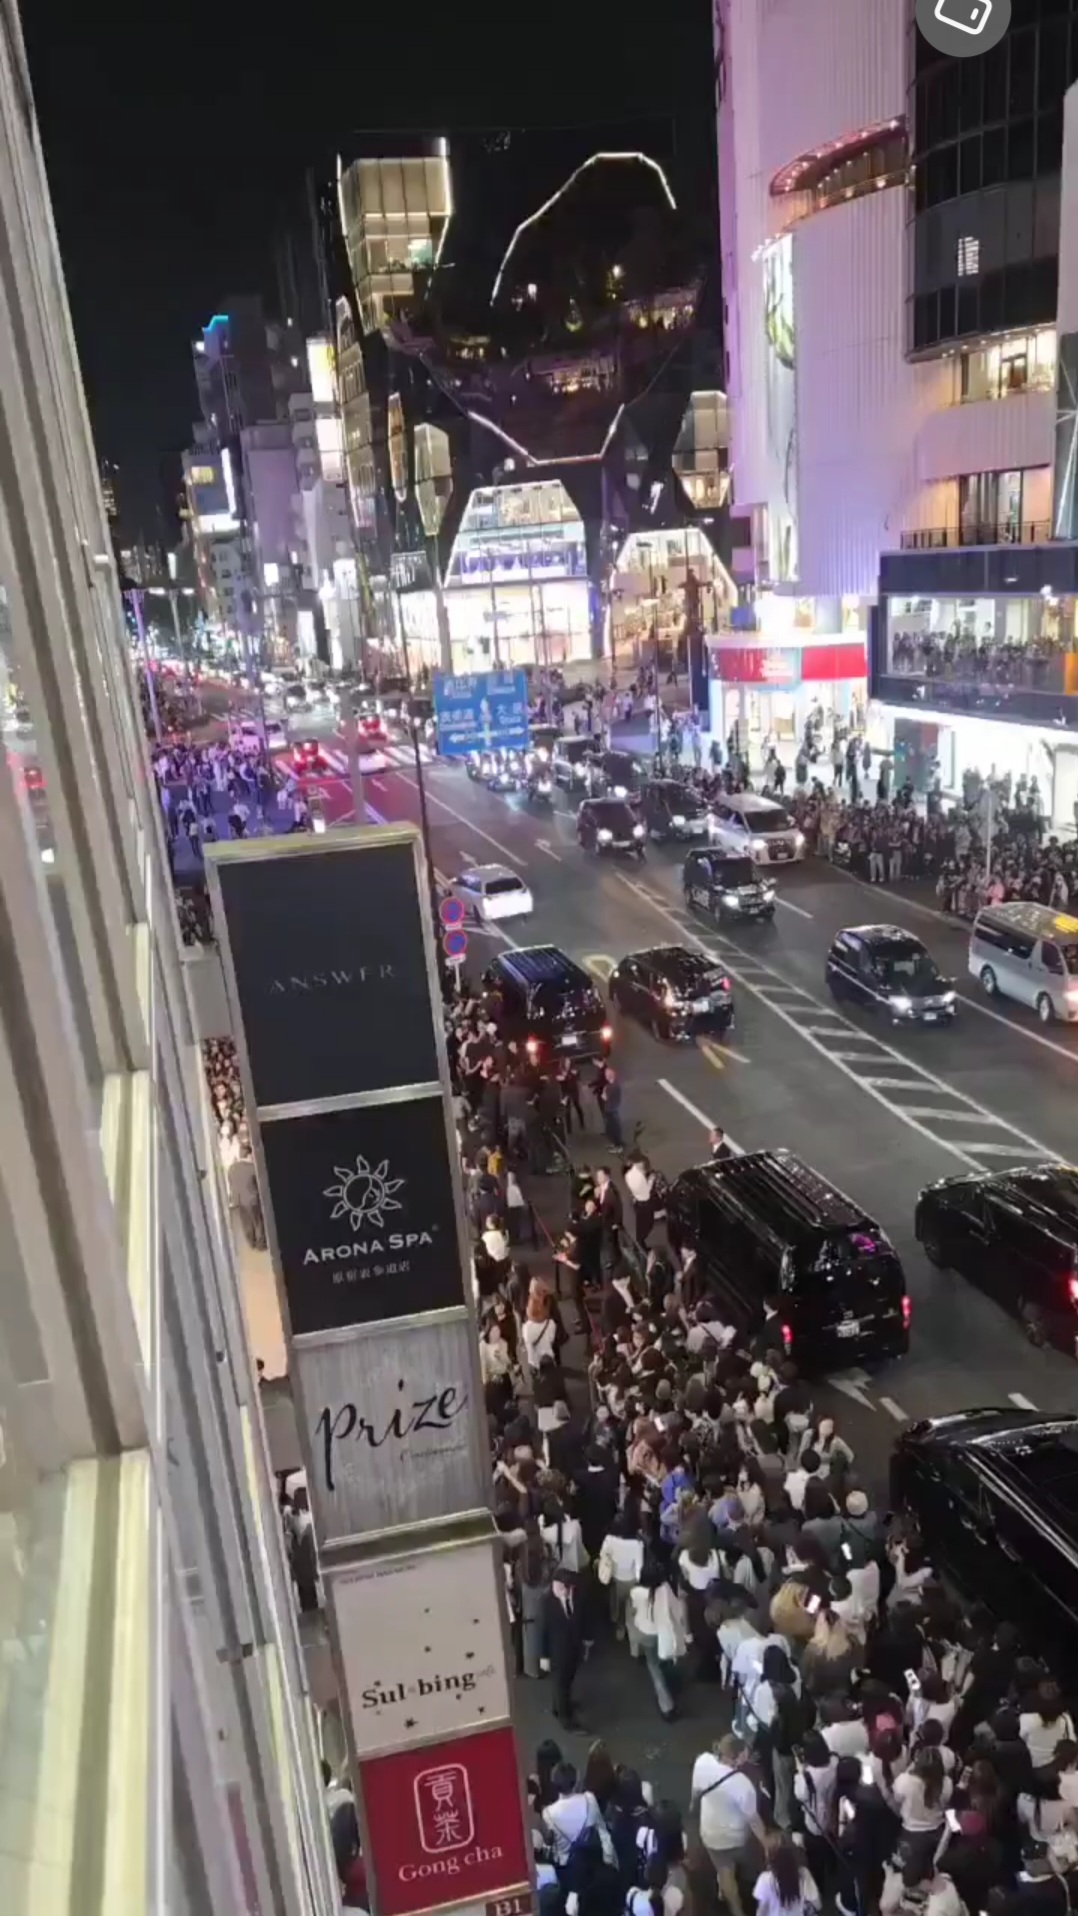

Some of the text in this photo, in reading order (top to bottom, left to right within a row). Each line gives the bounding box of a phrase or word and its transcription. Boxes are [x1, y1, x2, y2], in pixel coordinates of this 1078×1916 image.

[302, 1231, 433, 1265] ARONA SPA
[398, 1846, 504, 1882] Gong cha
[495, 1897, 526, 1916] B1
